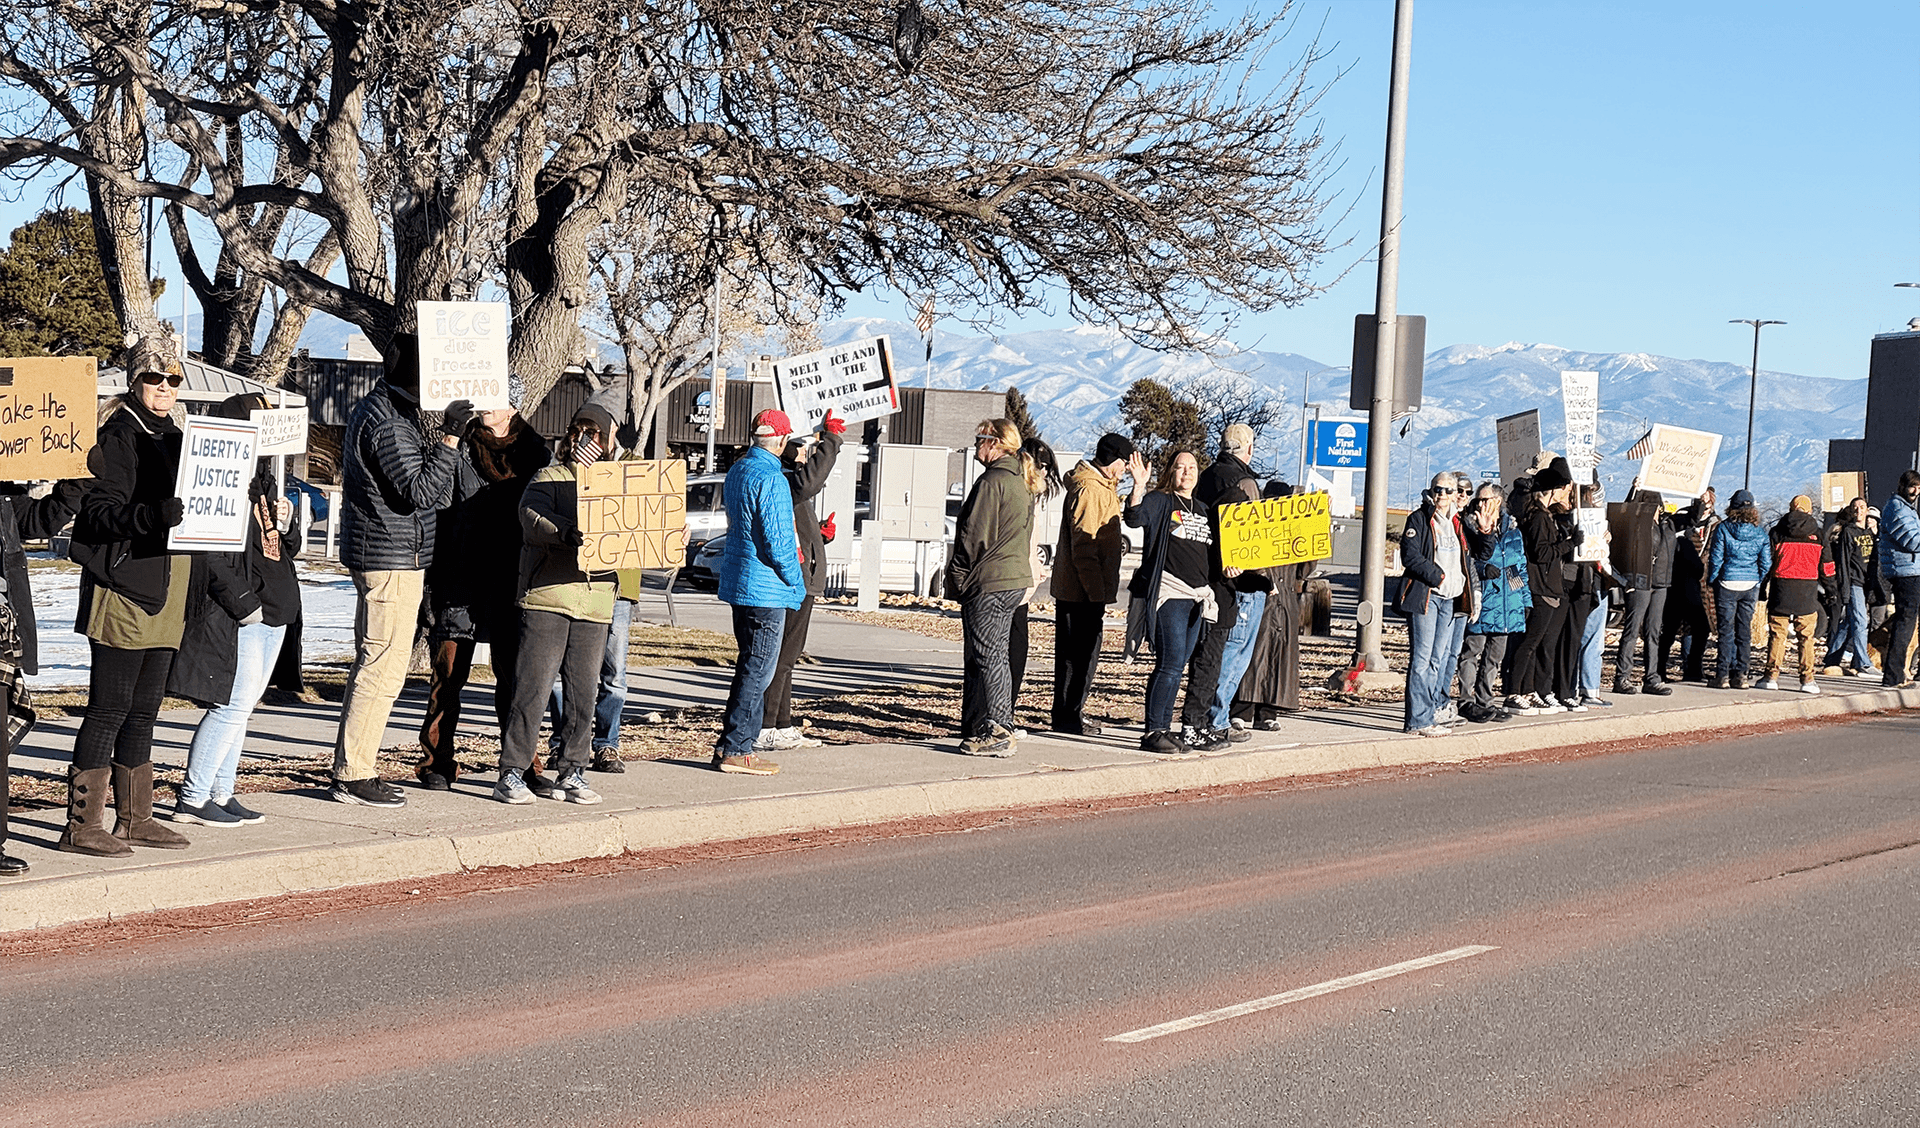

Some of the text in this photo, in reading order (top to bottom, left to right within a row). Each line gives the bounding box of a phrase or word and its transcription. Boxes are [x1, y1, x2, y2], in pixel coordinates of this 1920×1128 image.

[444, 339, 477, 354] due
[789, 346, 876, 378] MELT ICE AND
[791, 361, 868, 391] SEND THE
[428, 379, 500, 400] GESTAPO
[817, 382, 858, 401] WATER
[38, 392, 67, 419] the
[807, 394, 888, 420] TO SOMALIA
[262, 414, 301, 426] NO KINGS
[40, 422, 83, 454] Back
[1336, 438, 1354, 448] First
[242, 444, 250, 460] &
[1328, 446, 1362, 456] National
[1659, 441, 1707, 459] We the People
[1661, 454, 1685, 467] believe
[1654, 465, 1696, 483] Democracy
[578, 495, 684, 533] TRUMP
[1232, 496, 1321, 522] CAUTION
[1238, 523, 1292, 543] WATCH
[598, 530, 687, 568] GANG
[1230, 533, 1329, 563] FOR ICE
[1580, 549, 1607, 560] OOD
